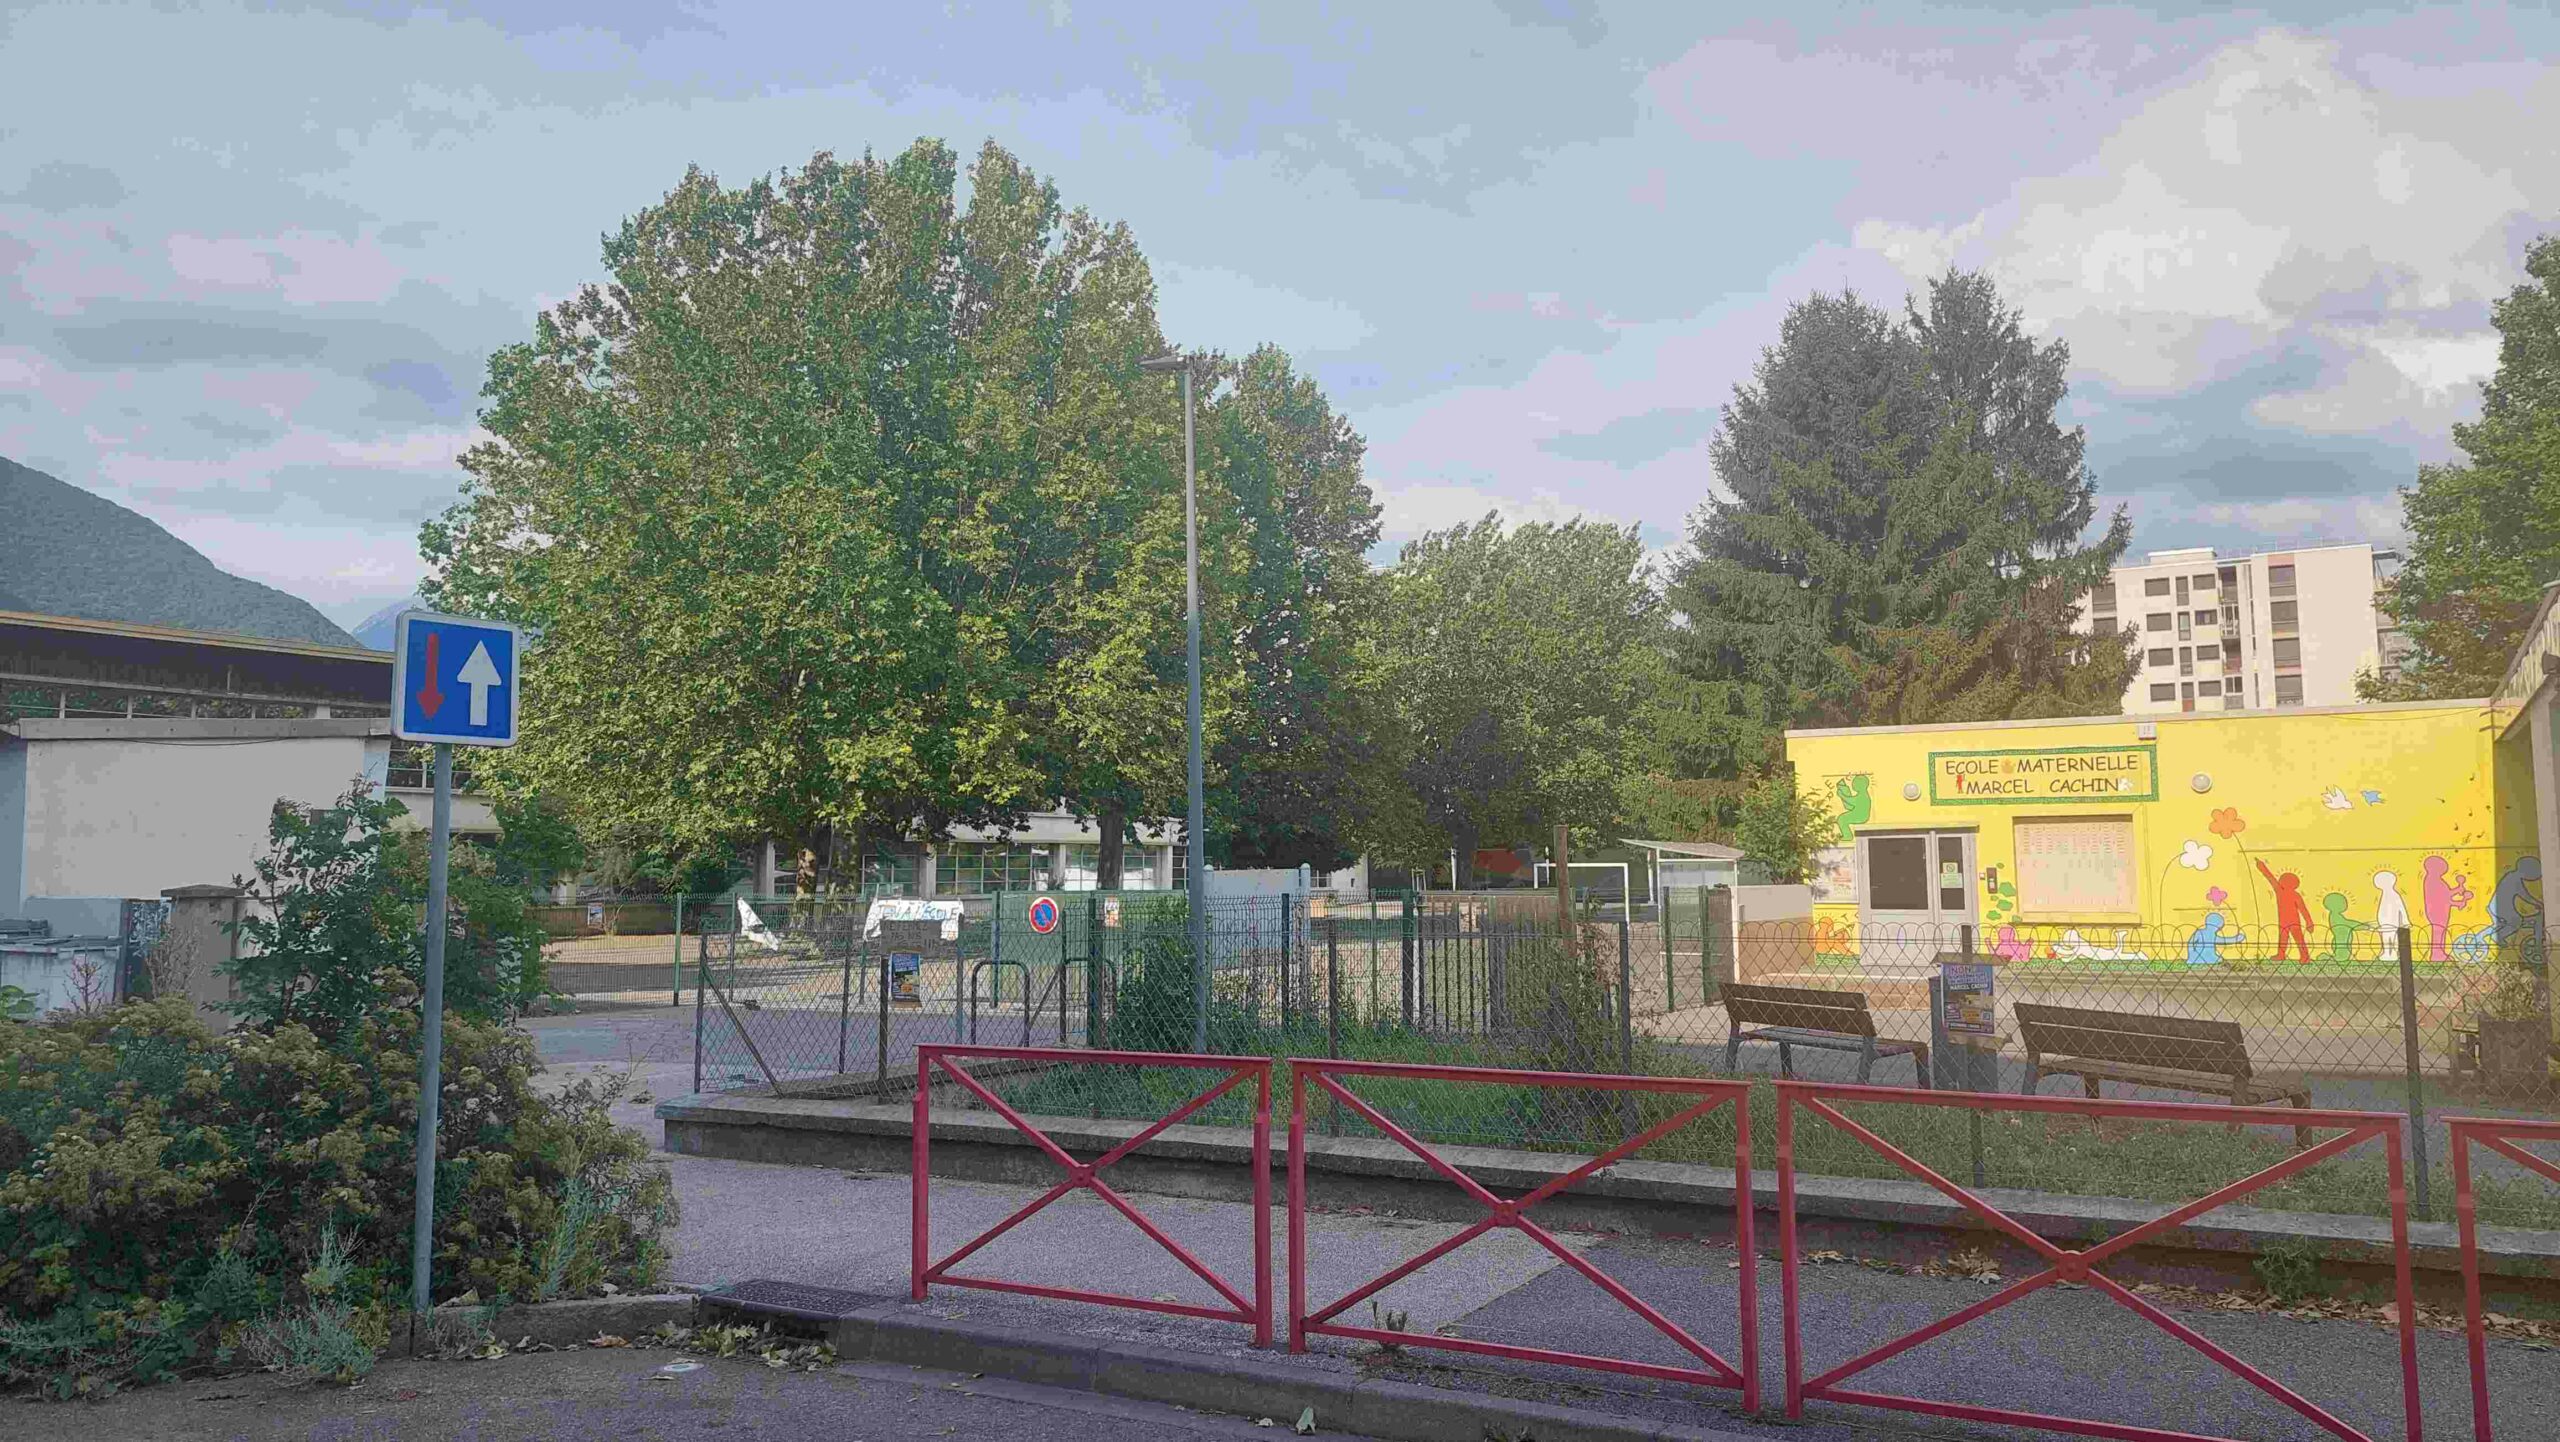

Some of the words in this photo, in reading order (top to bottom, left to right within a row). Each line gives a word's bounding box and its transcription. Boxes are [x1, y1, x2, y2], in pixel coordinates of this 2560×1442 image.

[1945, 759, 1999, 775] ECOLE
[2017, 754, 2138, 773] MATERNELLE
[1966, 779, 2035, 795] MARCEL
[2049, 778, 2119, 793] CACHIN
